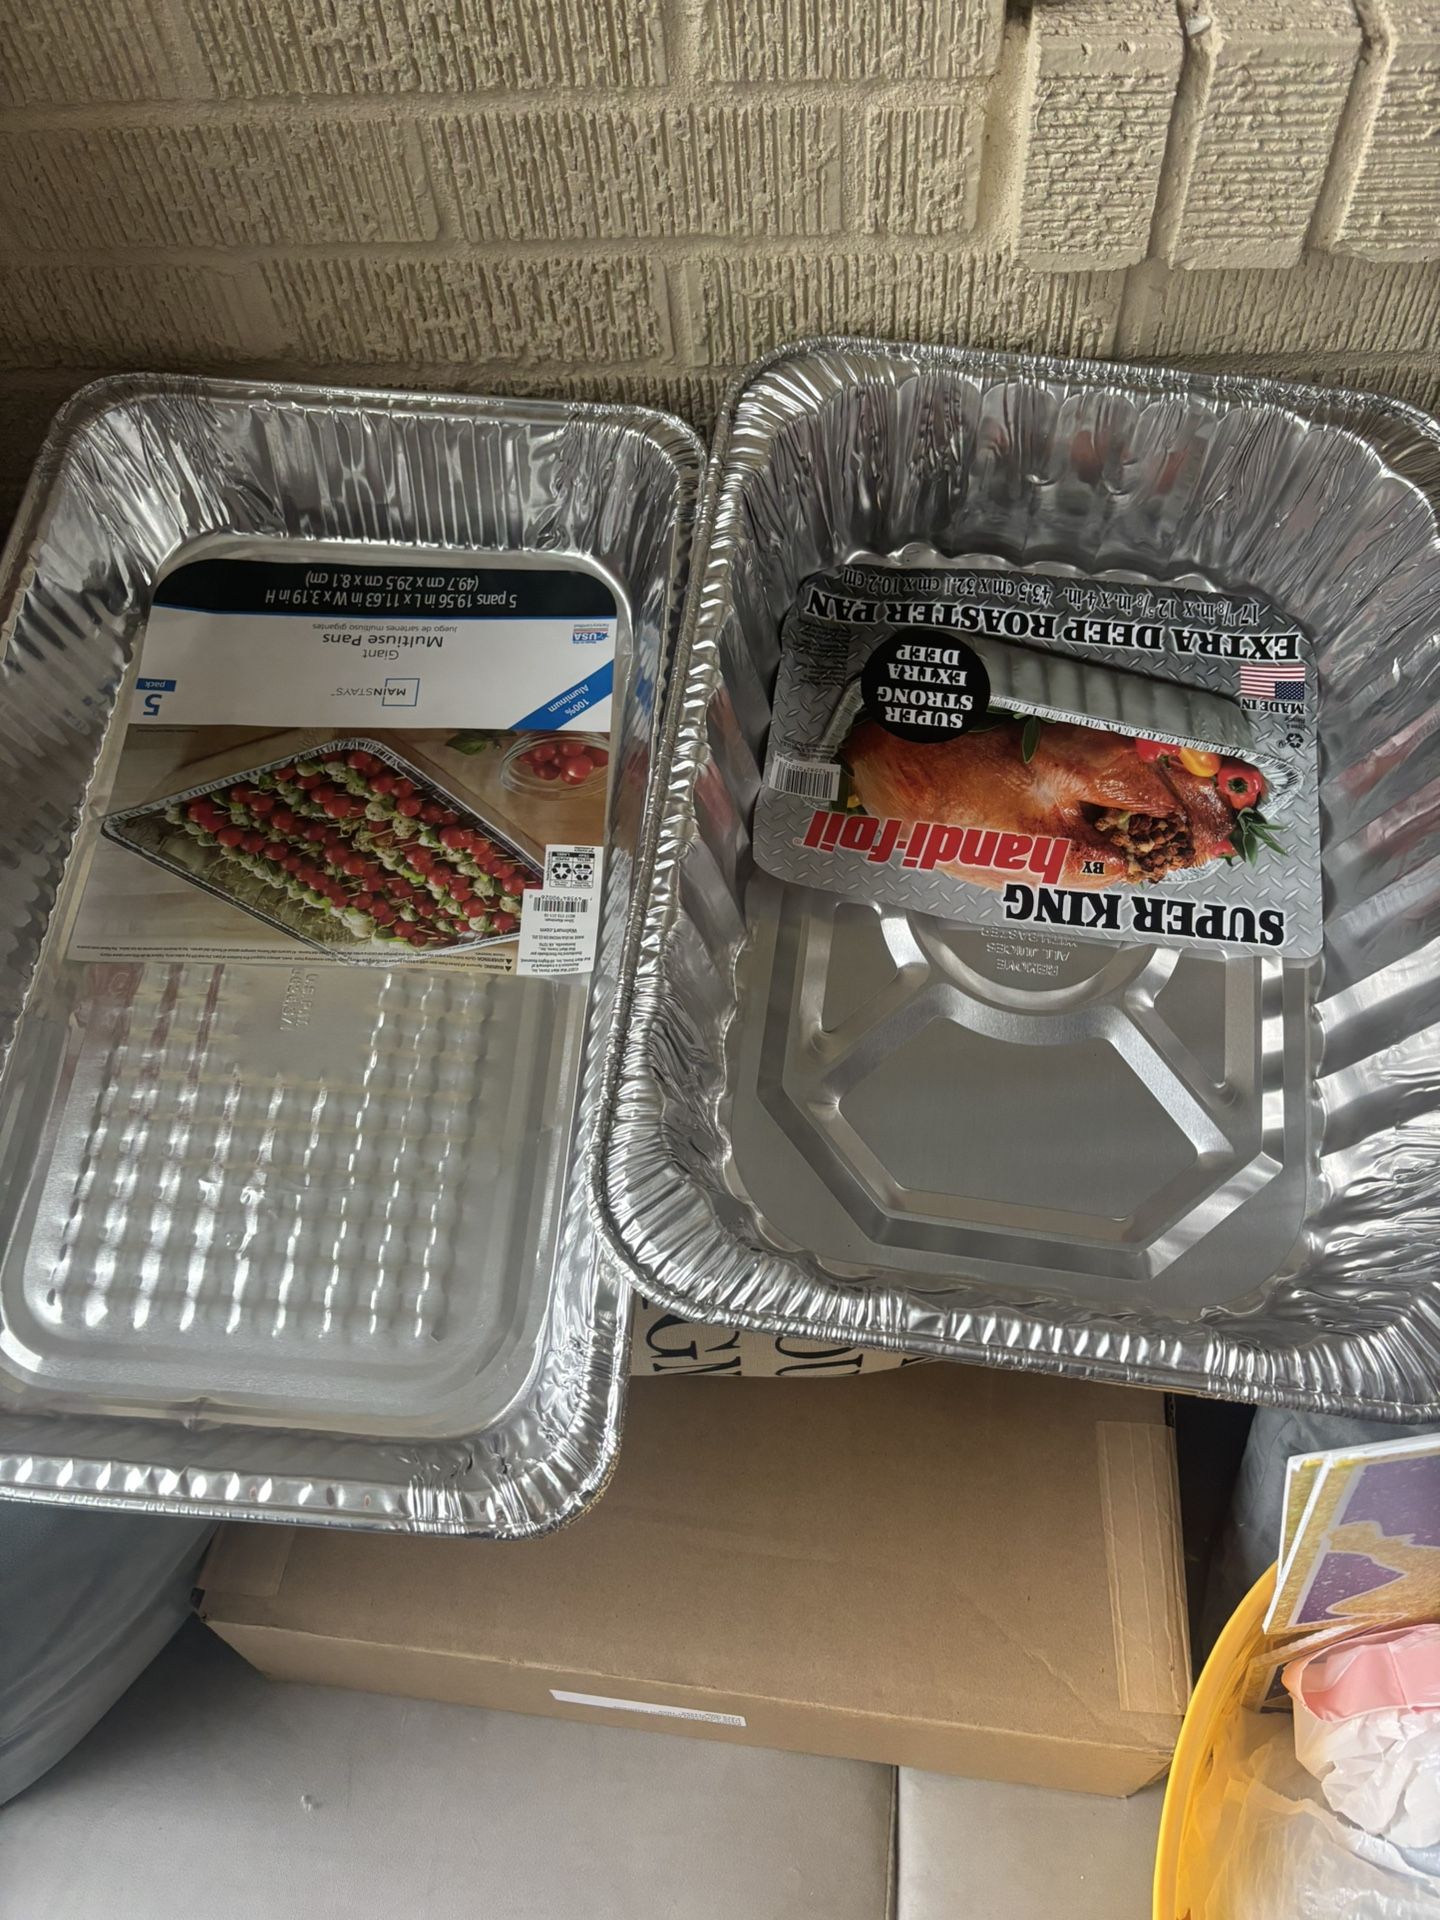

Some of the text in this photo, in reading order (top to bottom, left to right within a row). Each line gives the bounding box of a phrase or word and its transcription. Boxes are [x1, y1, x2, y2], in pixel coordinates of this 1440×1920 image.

[304, 570, 479, 592] (49.7 cm x 29.5 cm x 8.1 cm)
[843, 570, 866, 588] cm
[868, 575, 900, 594] 10.2
[903, 577, 913, 590] x
[918, 577, 940, 591] cm
[944, 576, 975, 595] 32.1
[978, 577, 989, 591] x
[993, 579, 1015, 596] cm
[264, 589, 518, 608] 5 pans 19.56 in L x 11.63 in W x 3.19 in H
[1018, 583, 1051, 605] 43.5
[1064, 588, 1082, 609] in.
[1086, 590, 1097, 610] 4
[1100, 592, 1110, 609] x
[1114, 595, 1132, 614] in.
[1183, 601, 1194, 617] x
[1196, 602, 1214, 623] in.
[312, 623, 347, 631] gigantes
[348, 624, 384, 632] multiuso
[421, 625, 432, 633] de
[433, 625, 458, 633] Juego
[806, 589, 1299, 660] EXTRA DEEP ROASTER PAN
[322, 633, 444, 648] Multiuse Pans
[573, 632, 597, 640] USA
[362, 648, 399, 661] Giant
[896, 644, 960, 666] DEEP
[887, 663, 967, 686] EXTRA
[144, 680, 167, 689] pack
[142, 693, 162, 716] 5
[547, 684, 590, 713] Aluminum
[564, 698, 590, 716] 100%
[876, 686, 973, 711] STRONG
[1241, 699, 1304, 714] MADE IN
[884, 706, 963, 728] SUPER
[803, 811, 1104, 885] BY handi-foil
[1002, 884, 1284, 946] SUPER KING
[986, 942, 1070, 962] ALL JUICES
